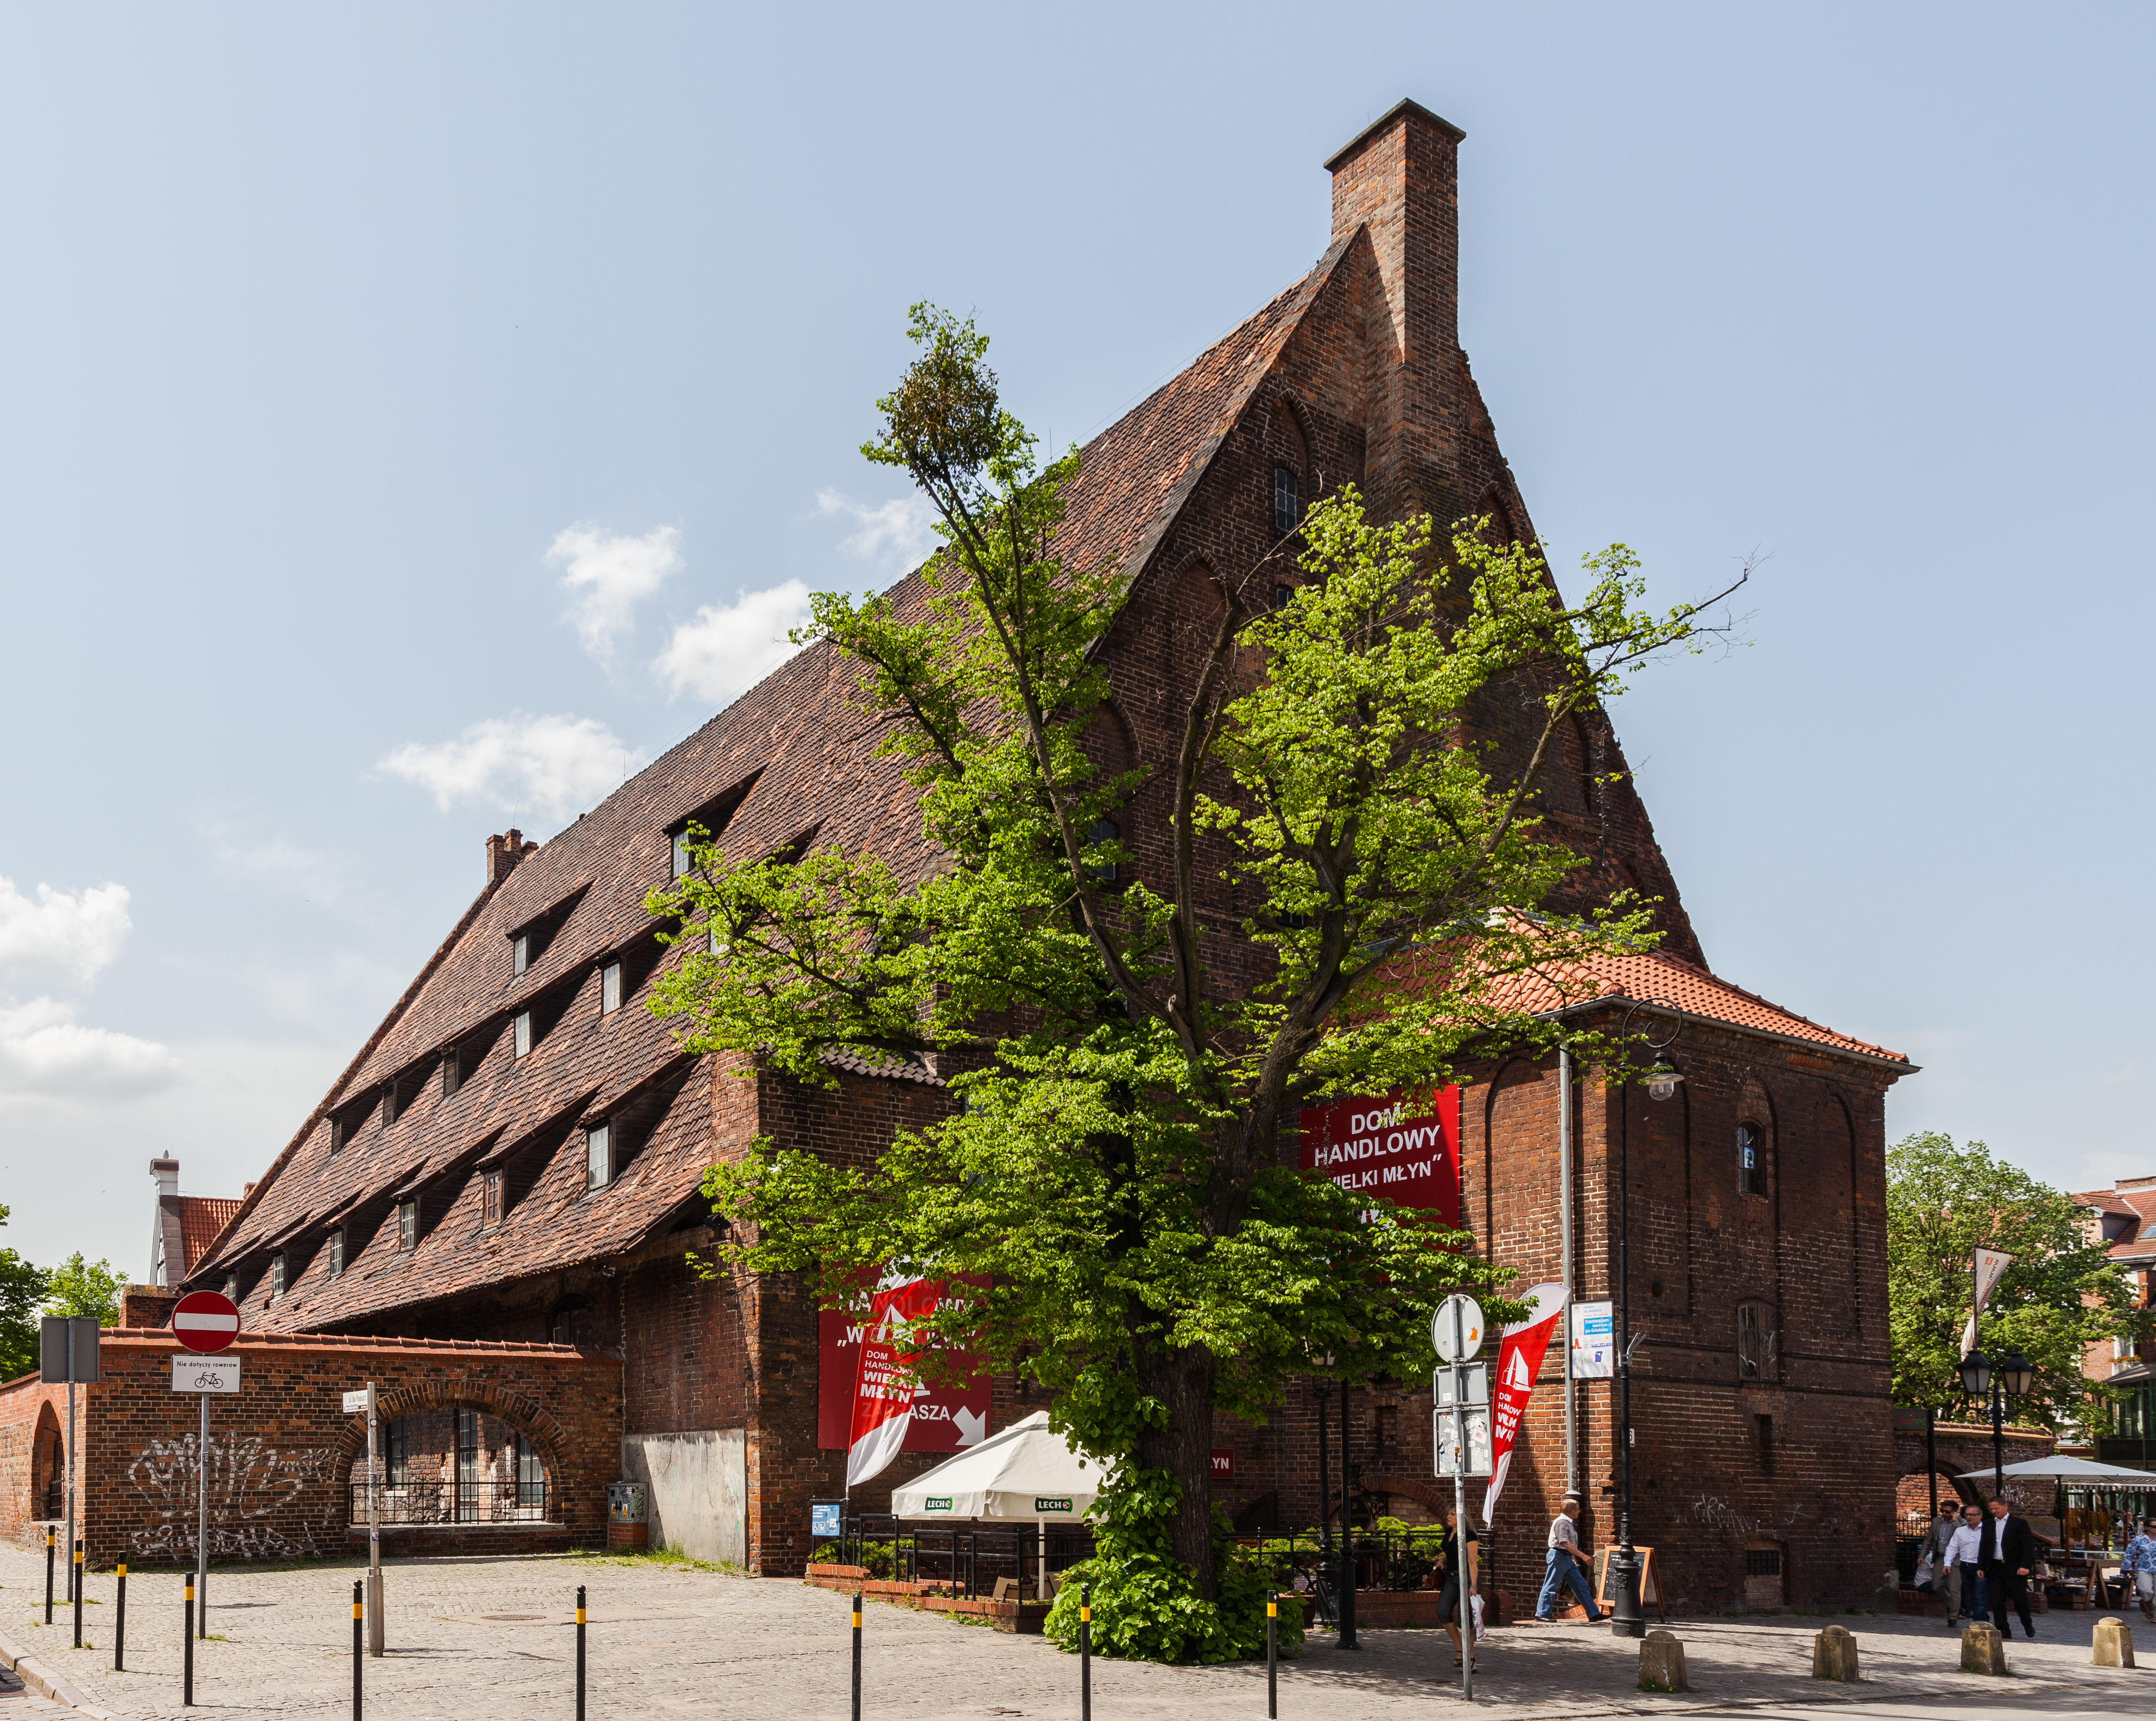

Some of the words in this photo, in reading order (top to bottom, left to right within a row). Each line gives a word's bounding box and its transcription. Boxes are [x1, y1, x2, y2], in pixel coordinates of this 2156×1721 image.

[1351, 1106, 1401, 1134] DOM
[1315, 1124, 1441, 1167] HANDLOWY
[1333, 1169, 1378, 1190] IELKI
[866, 1350, 888, 1361] DOM
[860, 1383, 911, 1403] MŁYN
[1038, 1501, 1062, 1509] LECH
